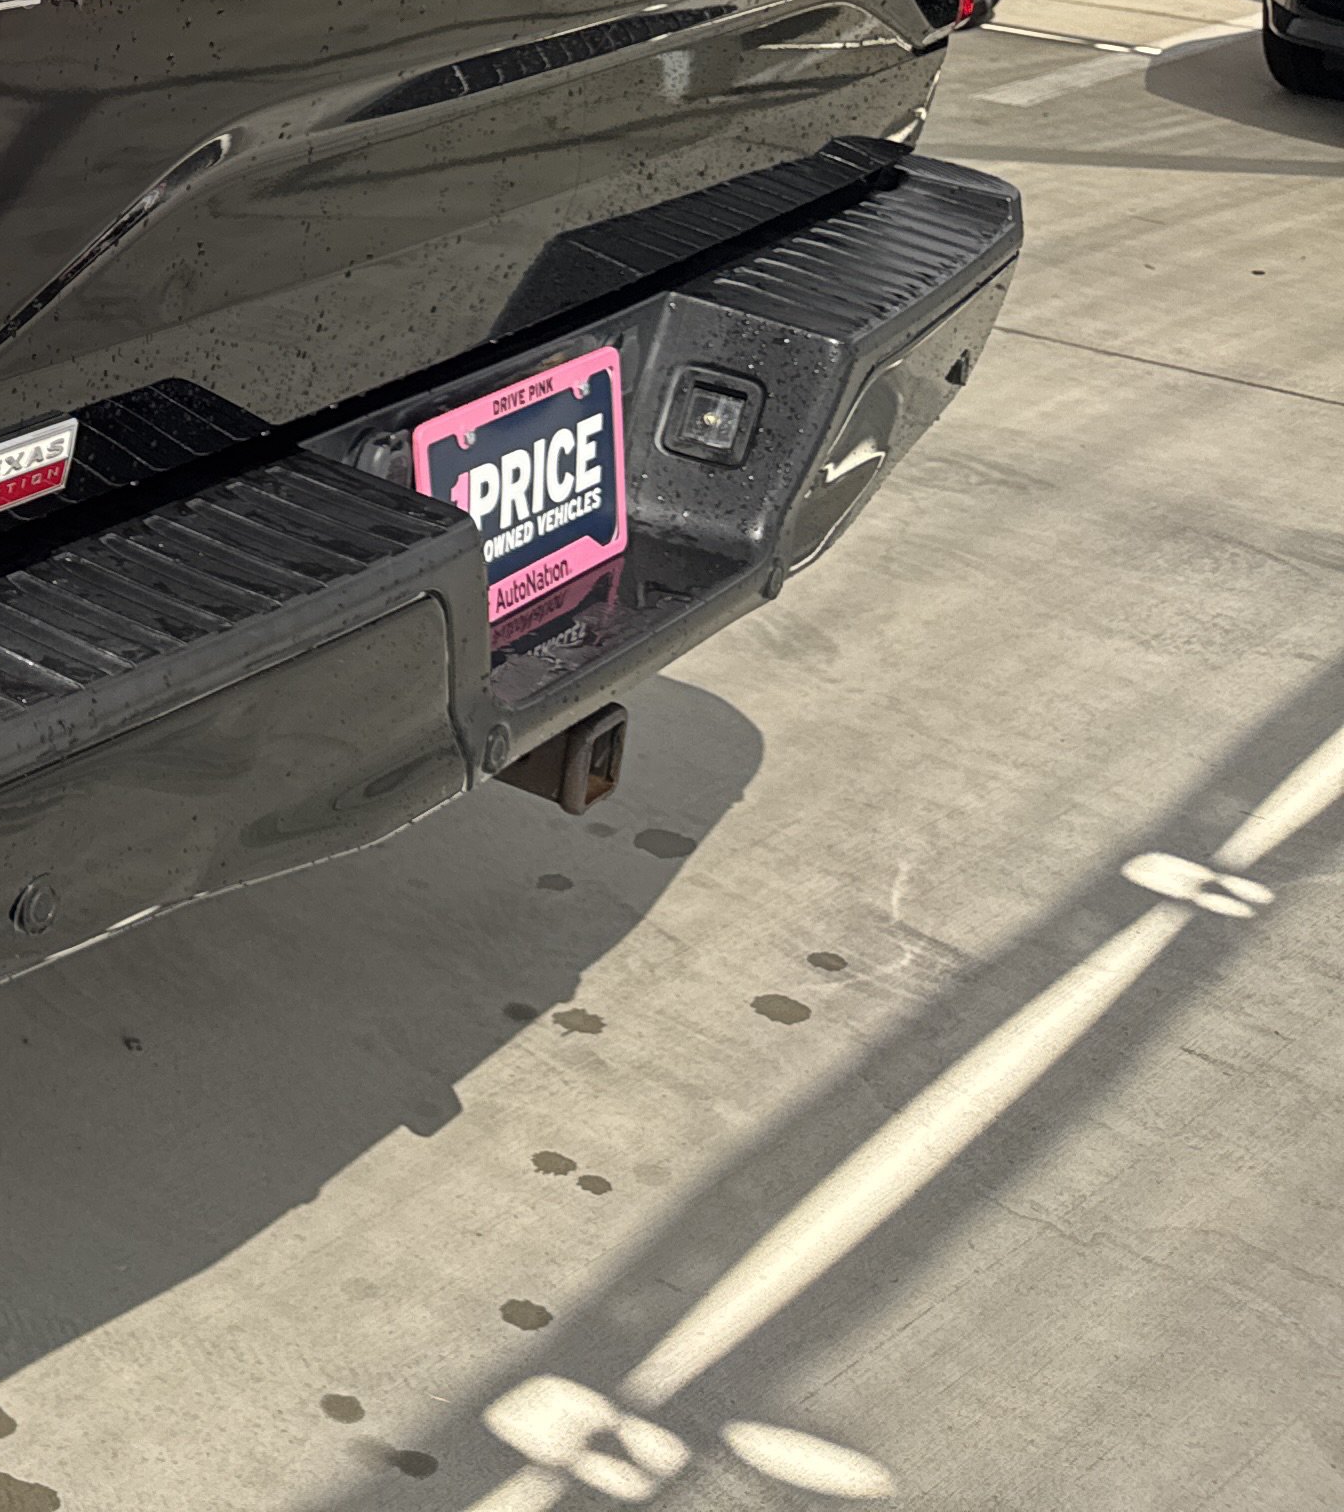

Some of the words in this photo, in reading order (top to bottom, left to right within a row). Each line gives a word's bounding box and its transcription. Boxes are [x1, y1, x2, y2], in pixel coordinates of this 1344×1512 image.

[493, 389, 526, 415] DRIVE
[528, 377, 554, 401] PINK
[483, 521, 534, 562] OWNED
[537, 487, 602, 535] VEHICLES
[496, 559, 570, 614] AutoNation
